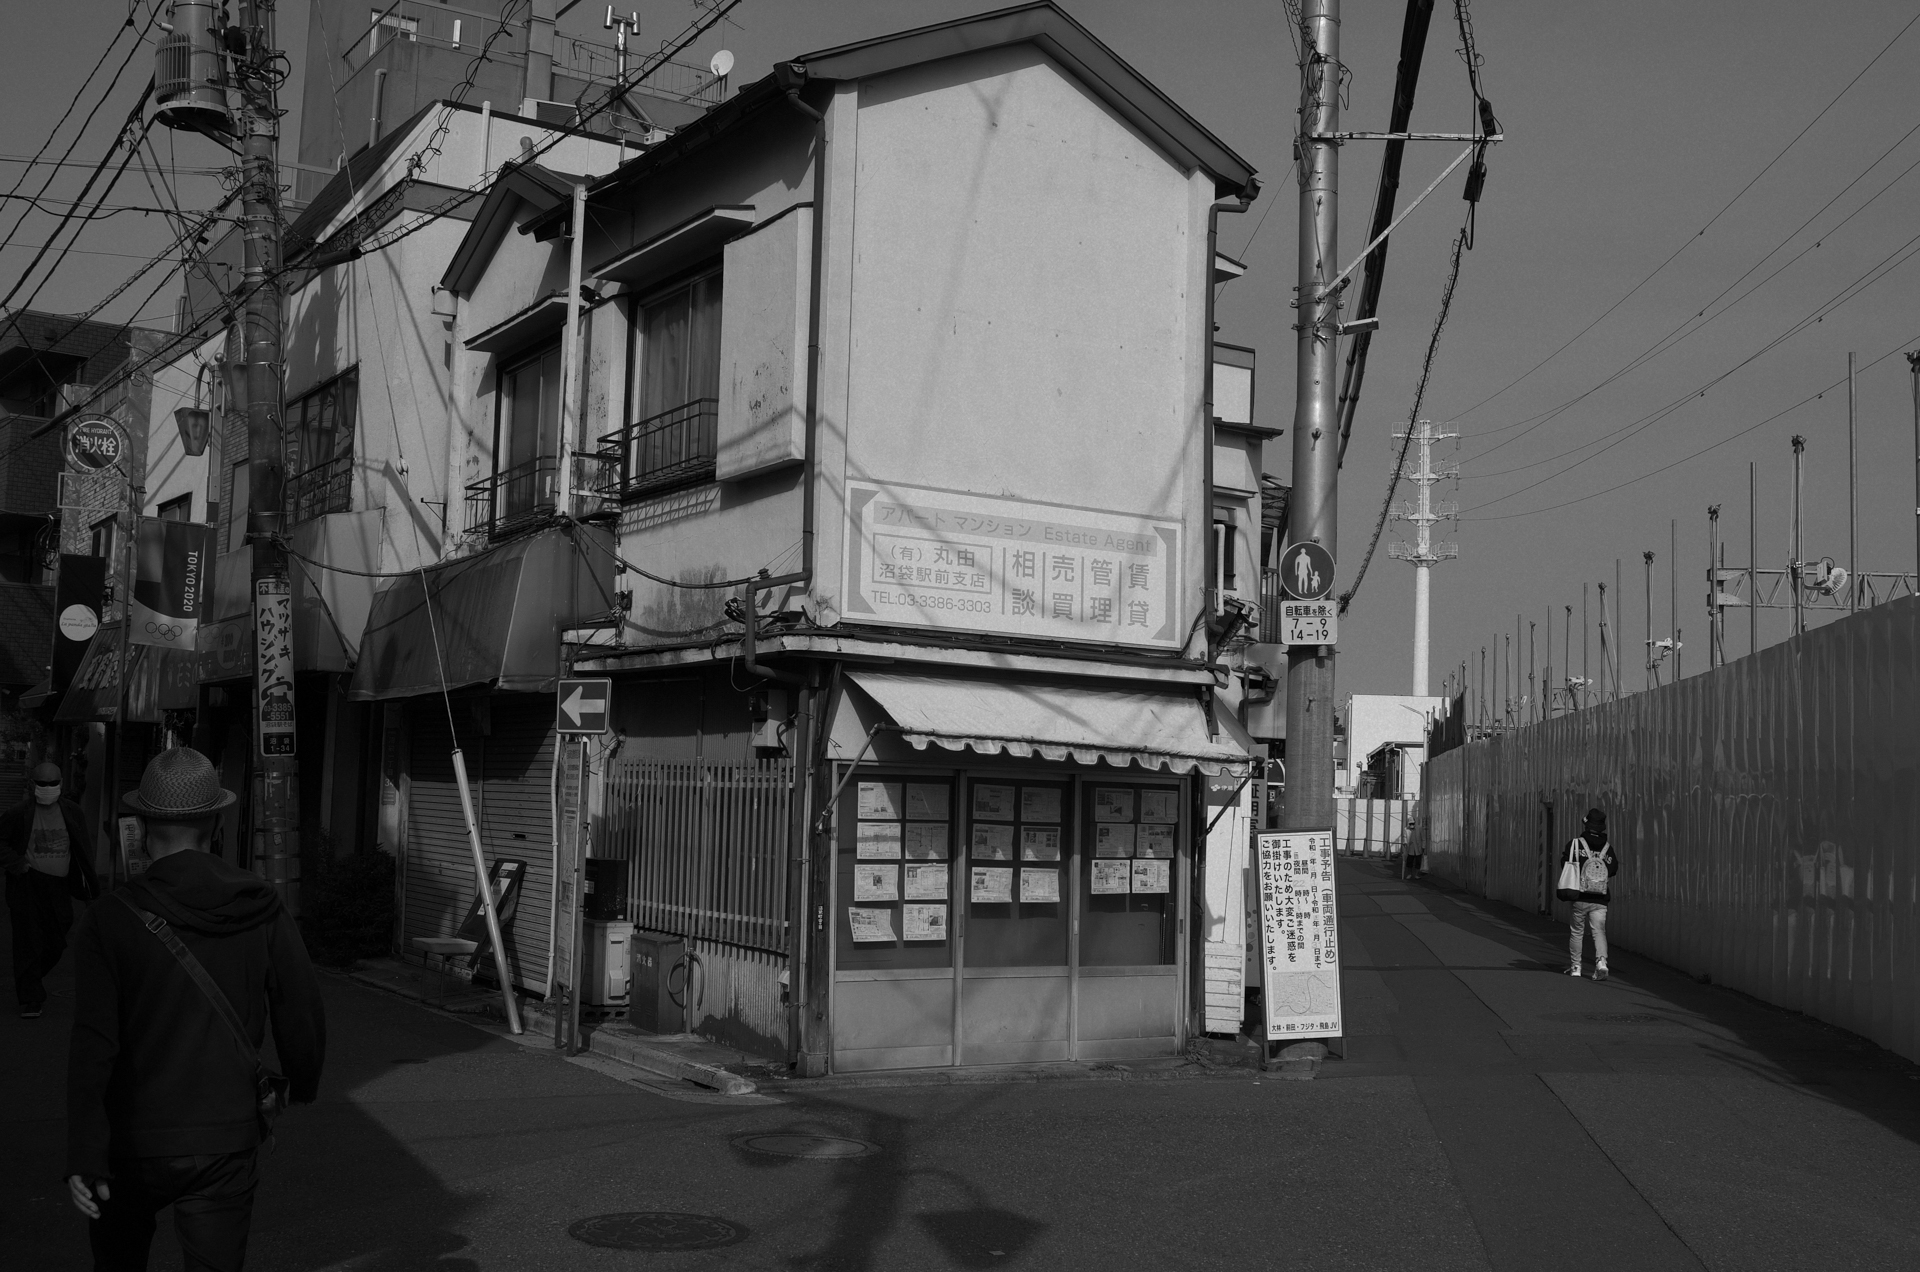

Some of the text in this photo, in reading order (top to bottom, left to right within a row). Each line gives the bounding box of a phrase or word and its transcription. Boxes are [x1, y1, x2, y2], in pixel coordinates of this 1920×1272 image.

[75, 435, 117, 456] 消火栓
[880, 505, 1152, 552] アパート マンション Estate Agent
[183, 551, 198, 612] TOKYO 2020
[871, 590, 992, 614] TEL:03-3386-3303
[879, 562, 986, 589] 沼袋駅前支店
[1011, 549, 1036, 617] 相談
[1051, 554, 1075, 621] 売買
[1089, 558, 1113, 624] 管理
[1127, 562, 1150, 628] 賃貸
[276, 598, 292, 661] マツザキ
[1285, 605, 1333, 616] 自転車を除く
[260, 607, 278, 683] ハウジング
[1282, 839, 1297, 963] 工事のため大変ご迷惑を
